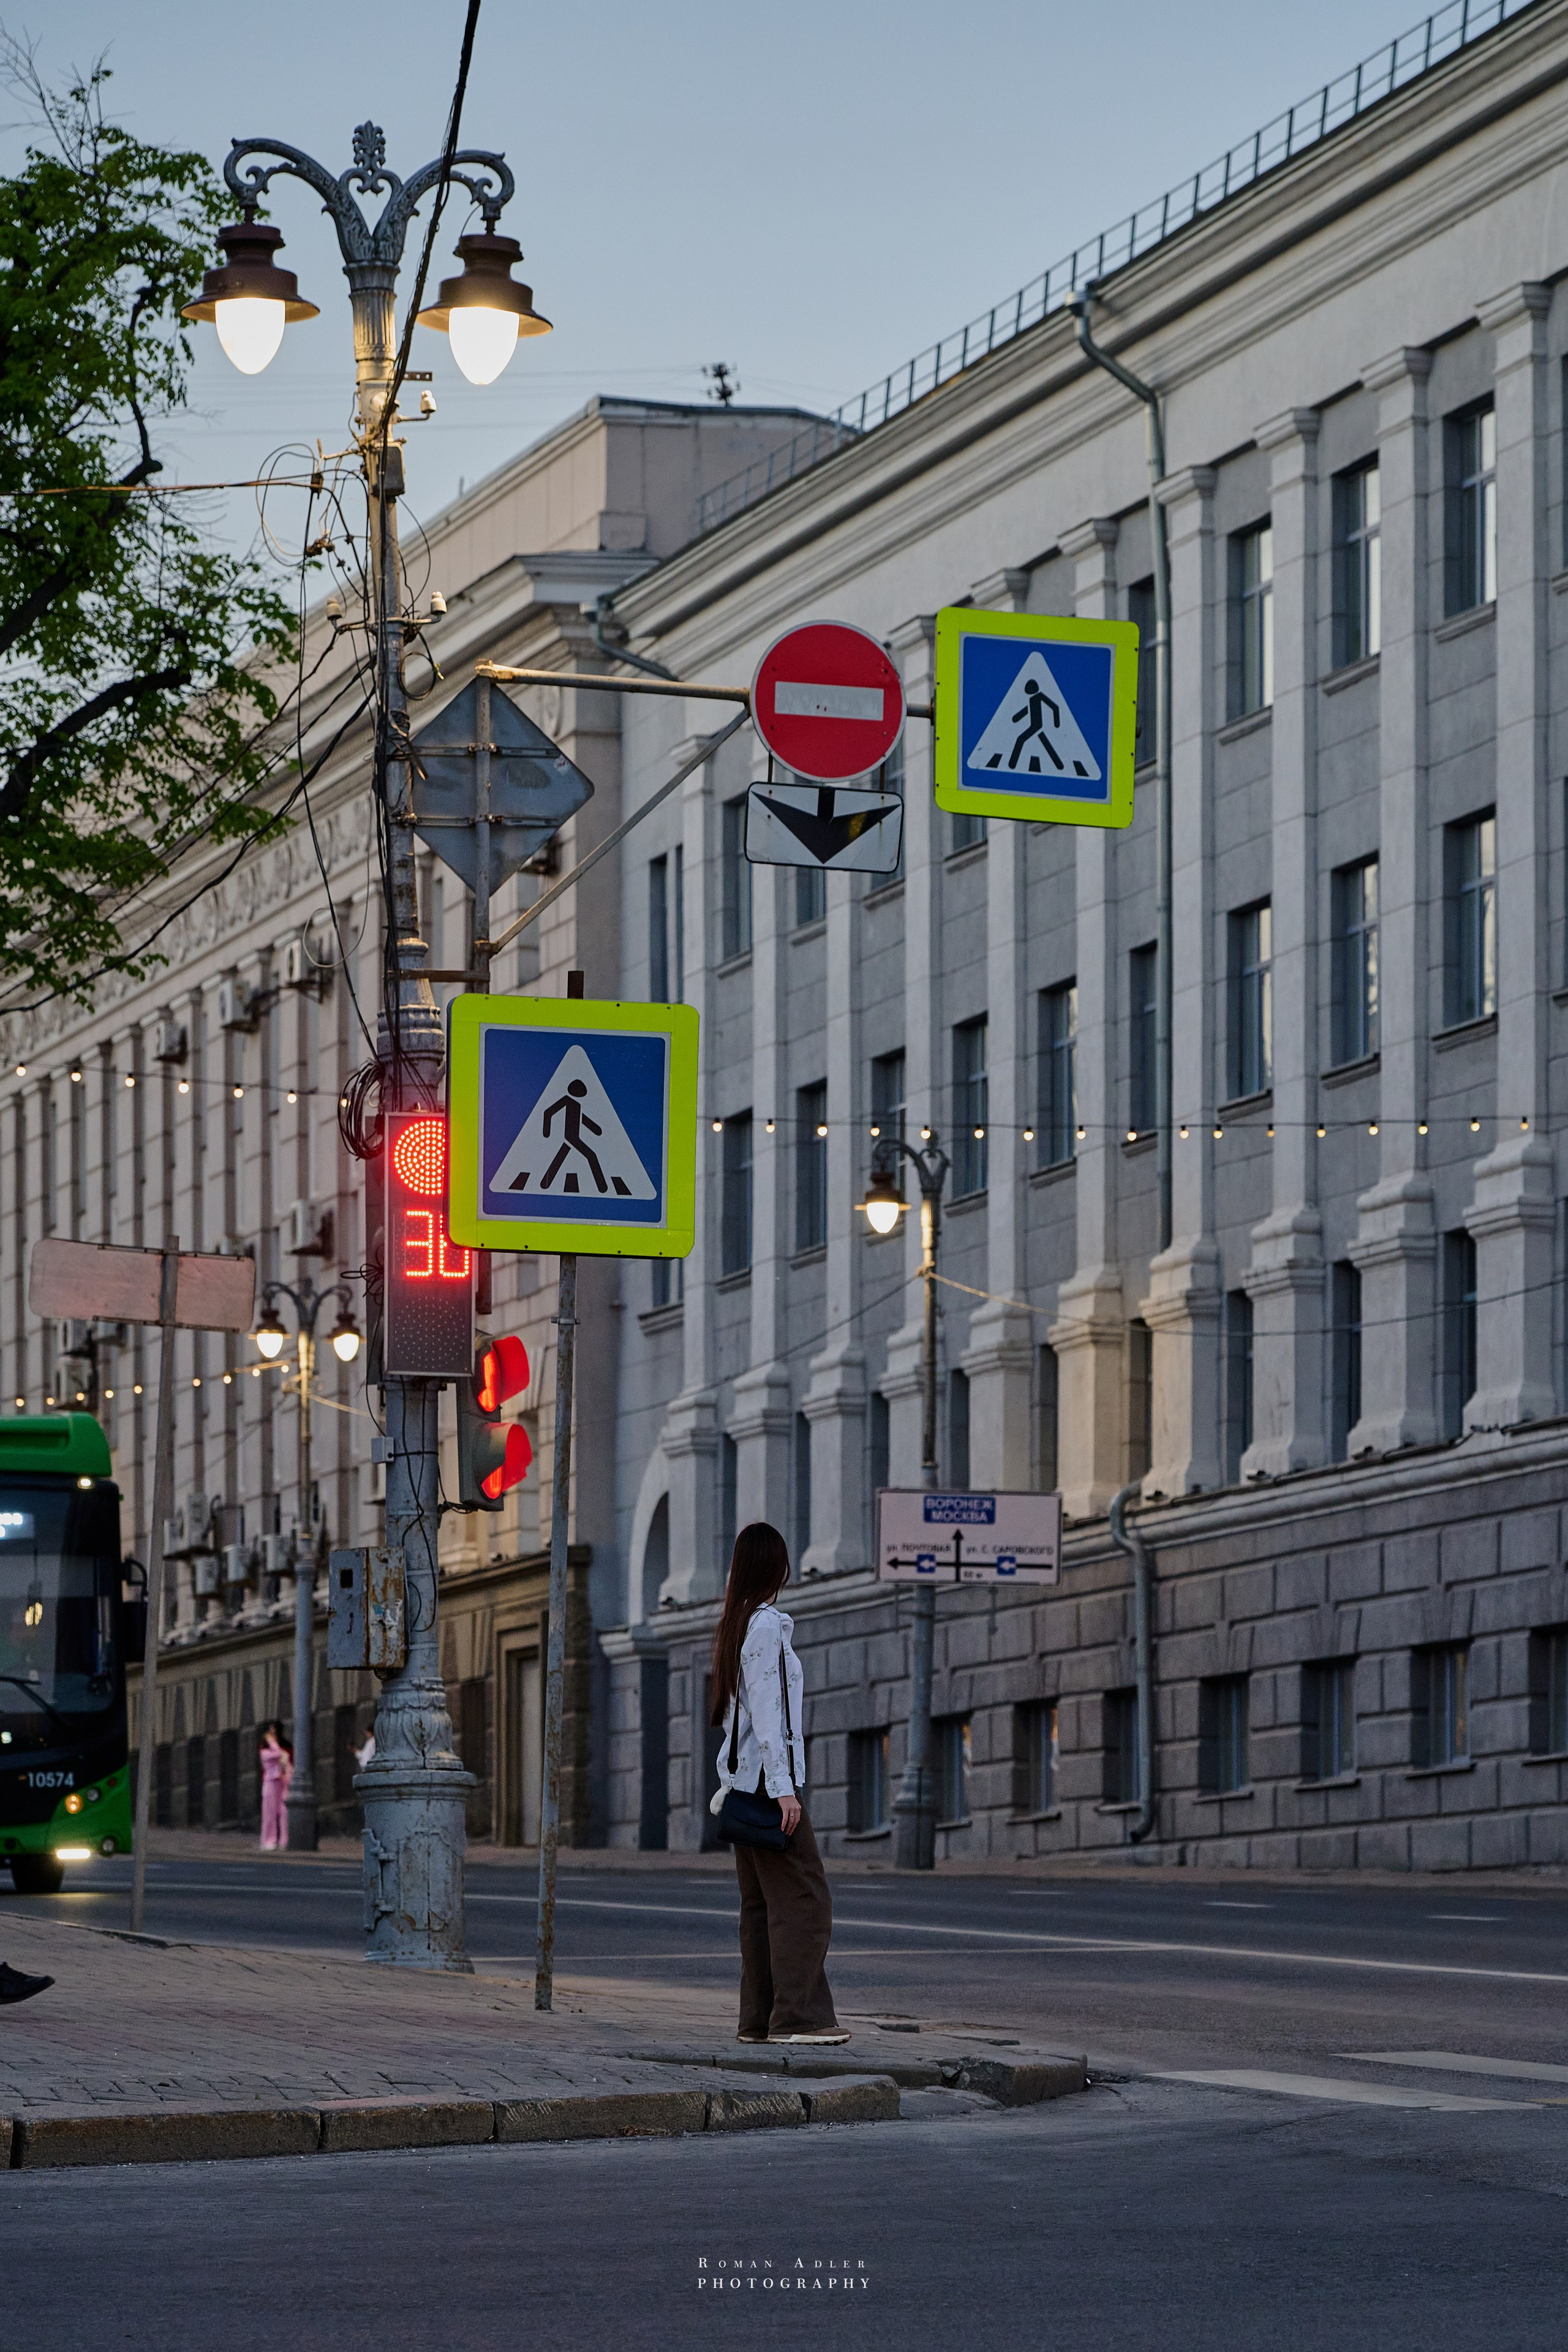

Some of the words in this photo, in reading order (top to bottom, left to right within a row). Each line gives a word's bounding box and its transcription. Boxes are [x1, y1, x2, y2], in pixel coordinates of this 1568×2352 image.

[925, 1498, 993, 1511] ВОРОНЕЖ
[931, 1511, 988, 1522] МОСКВА
[28, 1771, 75, 1788] 10574
